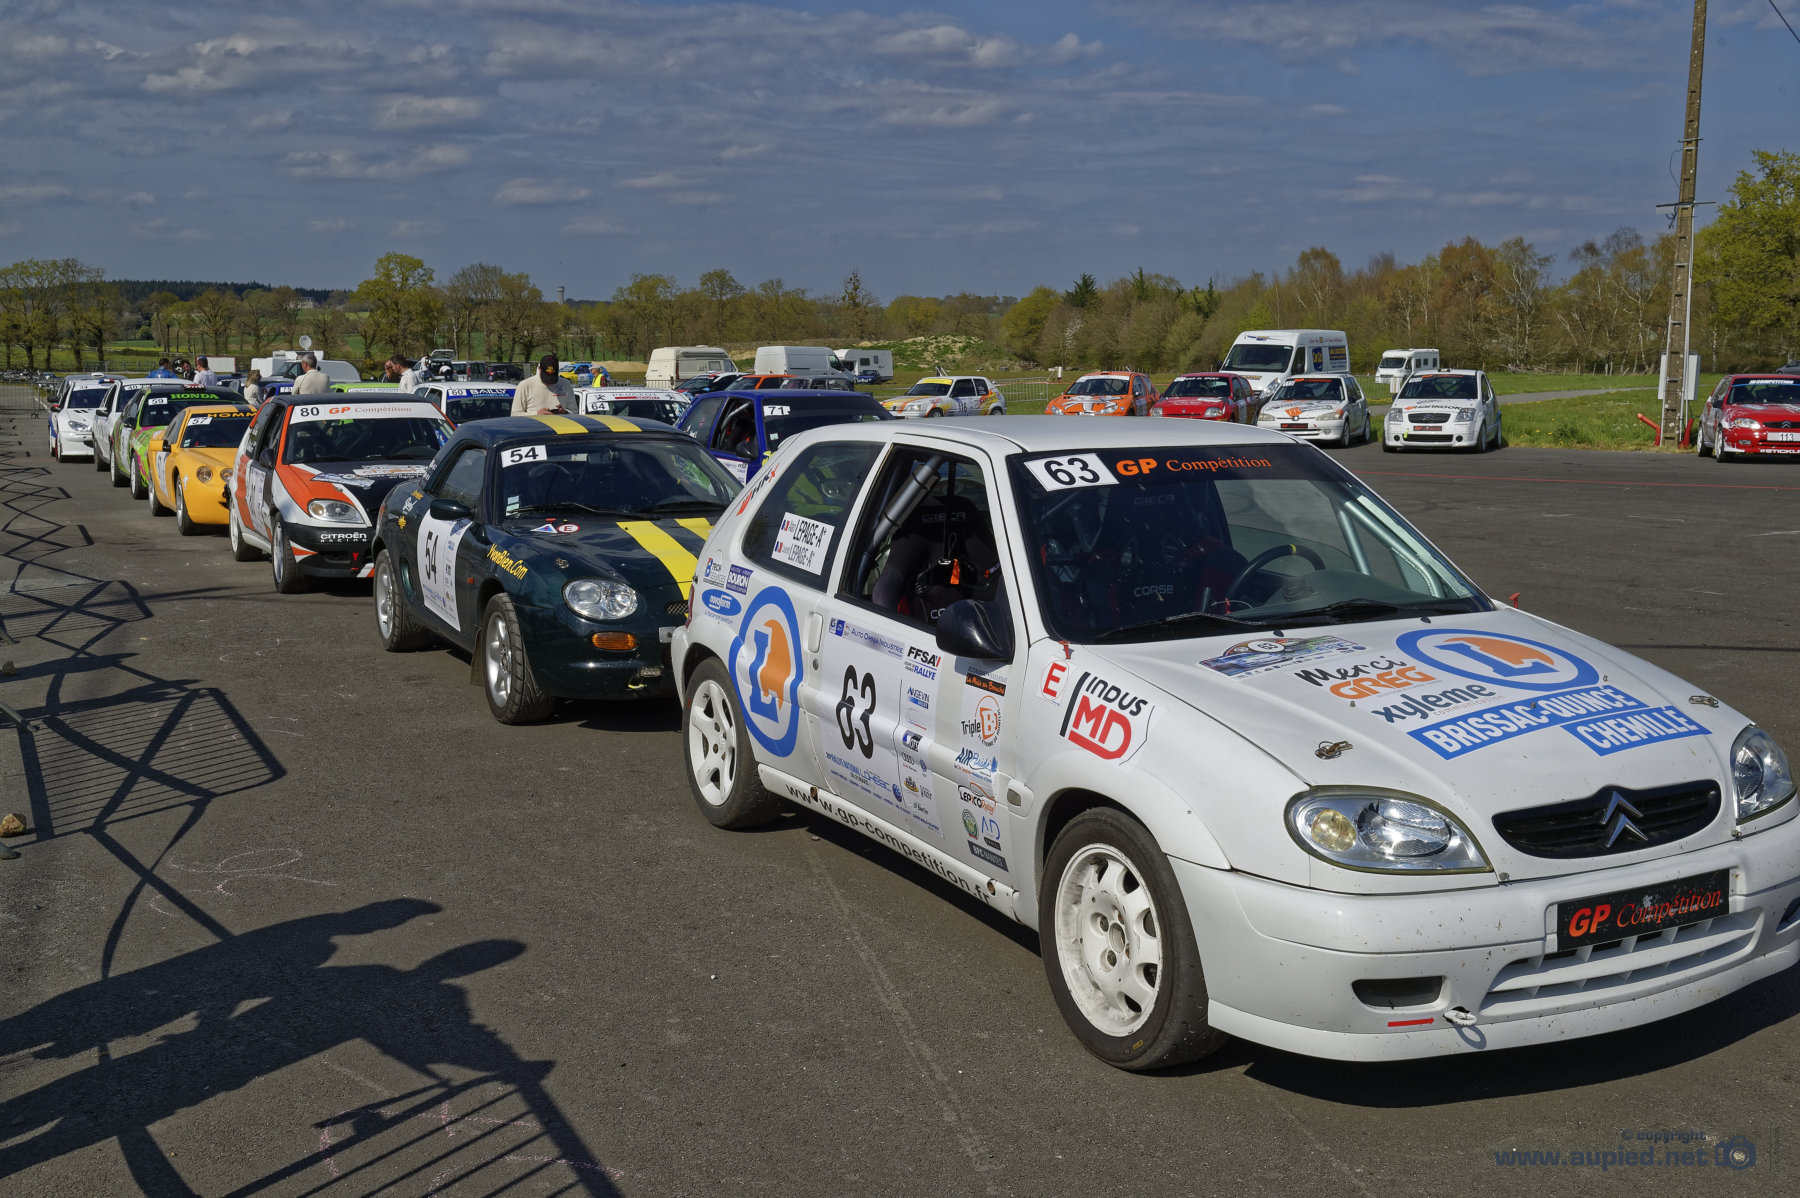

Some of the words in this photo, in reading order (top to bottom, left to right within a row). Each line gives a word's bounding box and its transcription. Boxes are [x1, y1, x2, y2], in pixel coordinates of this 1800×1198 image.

[300, 406, 320, 417] 80
[328, 406, 351, 415] GP
[591, 402, 605, 411] 64
[769, 406, 784, 415] 71
[510, 447, 539, 463] 54
[1043, 456, 1101, 486] 63
[1115, 458, 1158, 476] GP
[1166, 455, 1272, 472] Compétition
[320, 532, 367, 540] CITROËN
[425, 530, 439, 585] 54
[907, 646, 936, 667] FFSA
[1294, 655, 1407, 687] Merci
[913, 665, 936, 680] RALLYE
[1043, 662, 1067, 697] E
[1329, 665, 1437, 700] GREG
[836, 665, 876, 759] 63
[1371, 684, 1497, 724] xyleme
[961, 720, 981, 737] Triple
[1068, 695, 1132, 760] MD
[1568, 903, 1612, 938] GP
[1616, 888, 1722, 929] Compétition
